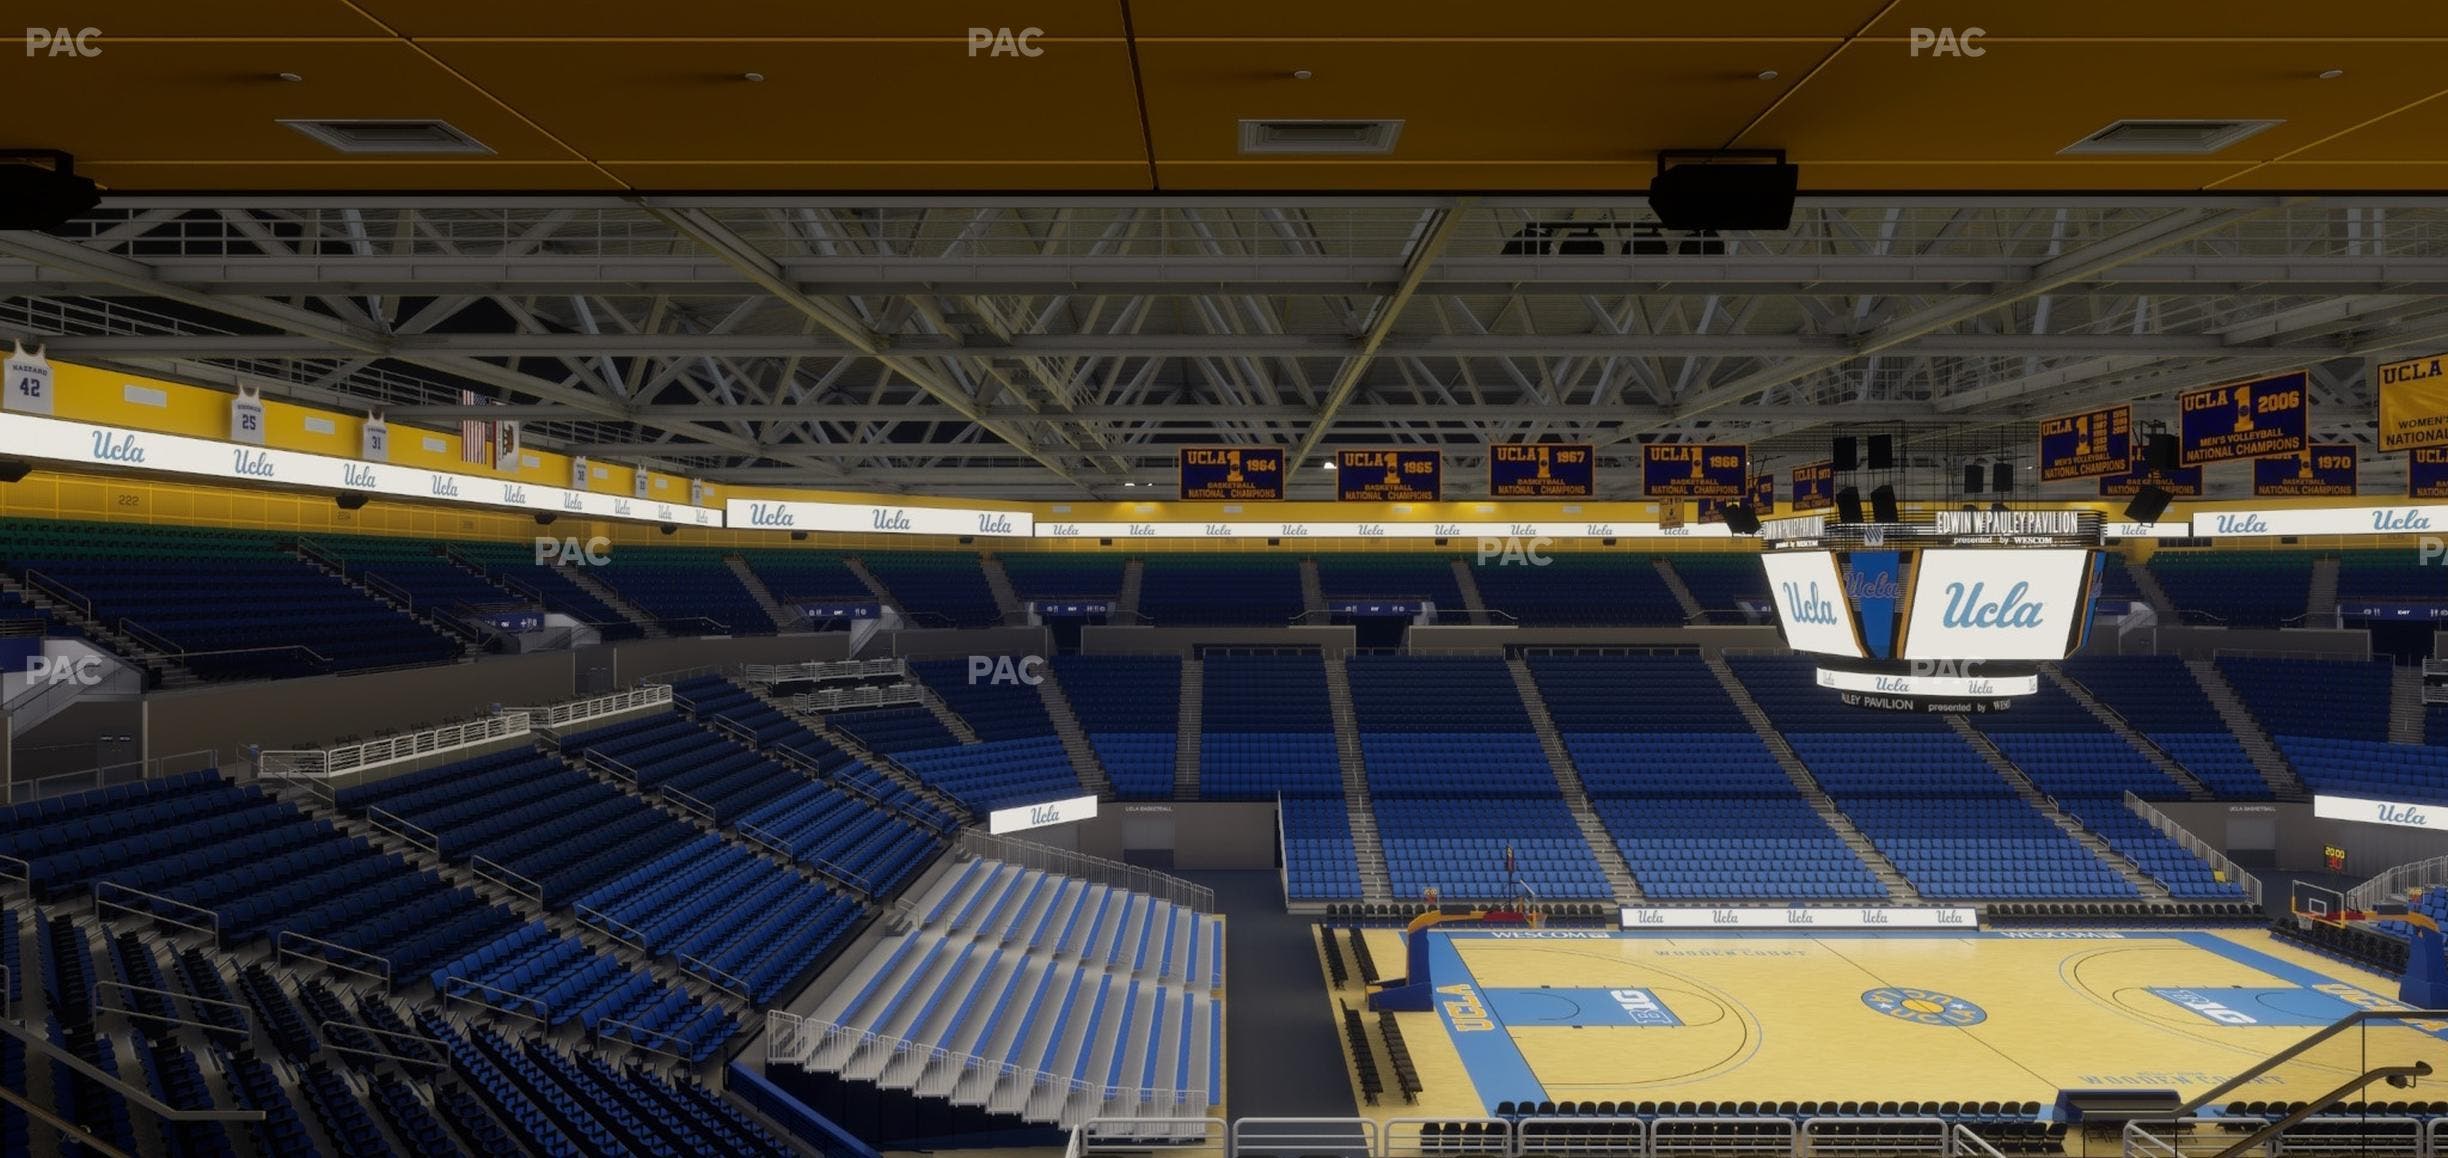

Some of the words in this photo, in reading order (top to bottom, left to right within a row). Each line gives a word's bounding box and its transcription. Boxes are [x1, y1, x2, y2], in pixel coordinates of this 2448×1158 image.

[2384, 360, 2442, 384] UCLA
[20, 377, 40, 398] 42
[2184, 389, 2228, 412] UCLA
[2257, 389, 2300, 414] 2006
[242, 413, 256, 430] 25
[2042, 418, 2072, 436] UCLA
[372, 435, 381, 450] 31
[2200, 436, 2226, 447] MEN'S
[2227, 428, 2284, 443] VOLLEYBALL
[92, 430, 145, 463] Ucla
[2186, 446, 2234, 461] NATIONAL
[2236, 436, 2300, 455] CHAMPIONS
[233, 448, 273, 477] Ucla
[1187, 450, 1227, 465] UCLA
[1246, 459, 1277, 472] 1964
[1344, 452, 1383, 467] UCLA
[1403, 461, 1433, 474] 1965
[1497, 447, 1536, 461] UCLA
[1556, 451, 1586, 464] 1967
[1650, 447, 1690, 461] UCLA
[1710, 456, 1739, 468] 1968
[2318, 456, 2351, 469] 1970
[2415, 449, 2448, 464] UCL
[344, 463, 376, 488] Ucla
[2044, 466, 2078, 479] NATIONAL
[2080, 458, 2126, 474] CHAMPIONS
[432, 474, 458, 497] Ucla
[1188, 489, 1225, 498] NATIONAL
[1230, 489, 1276, 498] CHAMPIONS
[1498, 485, 1536, 495] NATIONAL
[1540, 485, 1586, 495] CHAMPIONS
[1651, 485, 1689, 495] NATIONAL
[1693, 485, 1739, 495] CHAMPIONS
[2259, 485, 2299, 495] NATIONAL
[2302, 485, 2352, 495] CHAMPIONS
[503, 484, 525, 505] Ucla
[1345, 491, 1383, 500] NATIONAL
[1387, 491, 1432, 500] CHAMPIONS
[750, 503, 794, 526] Ucla
[872, 509, 910, 530] Ucla
[978, 513, 1011, 533] Ucla
[1937, 511, 1972, 534] EDWIN
[1988, 511, 2028, 534] PAULEY
[2029, 511, 2078, 534] PAVILION
[2217, 513, 2267, 533] Ucla
[2373, 509, 2430, 530] Ucla
[1053, 524, 1079, 536] Ucla
[1129, 524, 1155, 536] Ucla
[1206, 524, 1232, 536] Ucla
[1282, 524, 1308, 536] Ucla
[1358, 524, 1384, 536] Ucla
[1434, 524, 1460, 536] Ucla
[1511, 524, 1537, 536] Ucla
[1587, 524, 1613, 536] Ucla
[2121, 524, 2147, 536] Ucla
[1954, 536, 1993, 545] presented
[2000, 536, 2009, 545] by
[2014, 536, 2053, 545] WESCOM
[1843, 571, 1902, 599] Ucla
[1783, 581, 1837, 625] Ucla
[1943, 580, 2043, 629] Ucla
[1875, 676, 1910, 693] Ucla
[1968, 680, 1993, 694] Ucla
[1864, 696, 1913, 711] PAVILION
[1928, 702, 1971, 712] presented
[1977, 702, 1986, 714] by
[1030, 805, 1060, 825] Ucla
[2377, 804, 2427, 826] Ucla
[1638, 910, 1664, 924] Ucla
[1713, 910, 1739, 924] Ucla
[1787, 910, 1813, 924] Ucla
[1862, 910, 1888, 924] Ucla
[1936, 910, 1963, 924] Ucla
[1491, 931, 1588, 939] WESCOM
[1436, 984, 1496, 1032] UCLA
